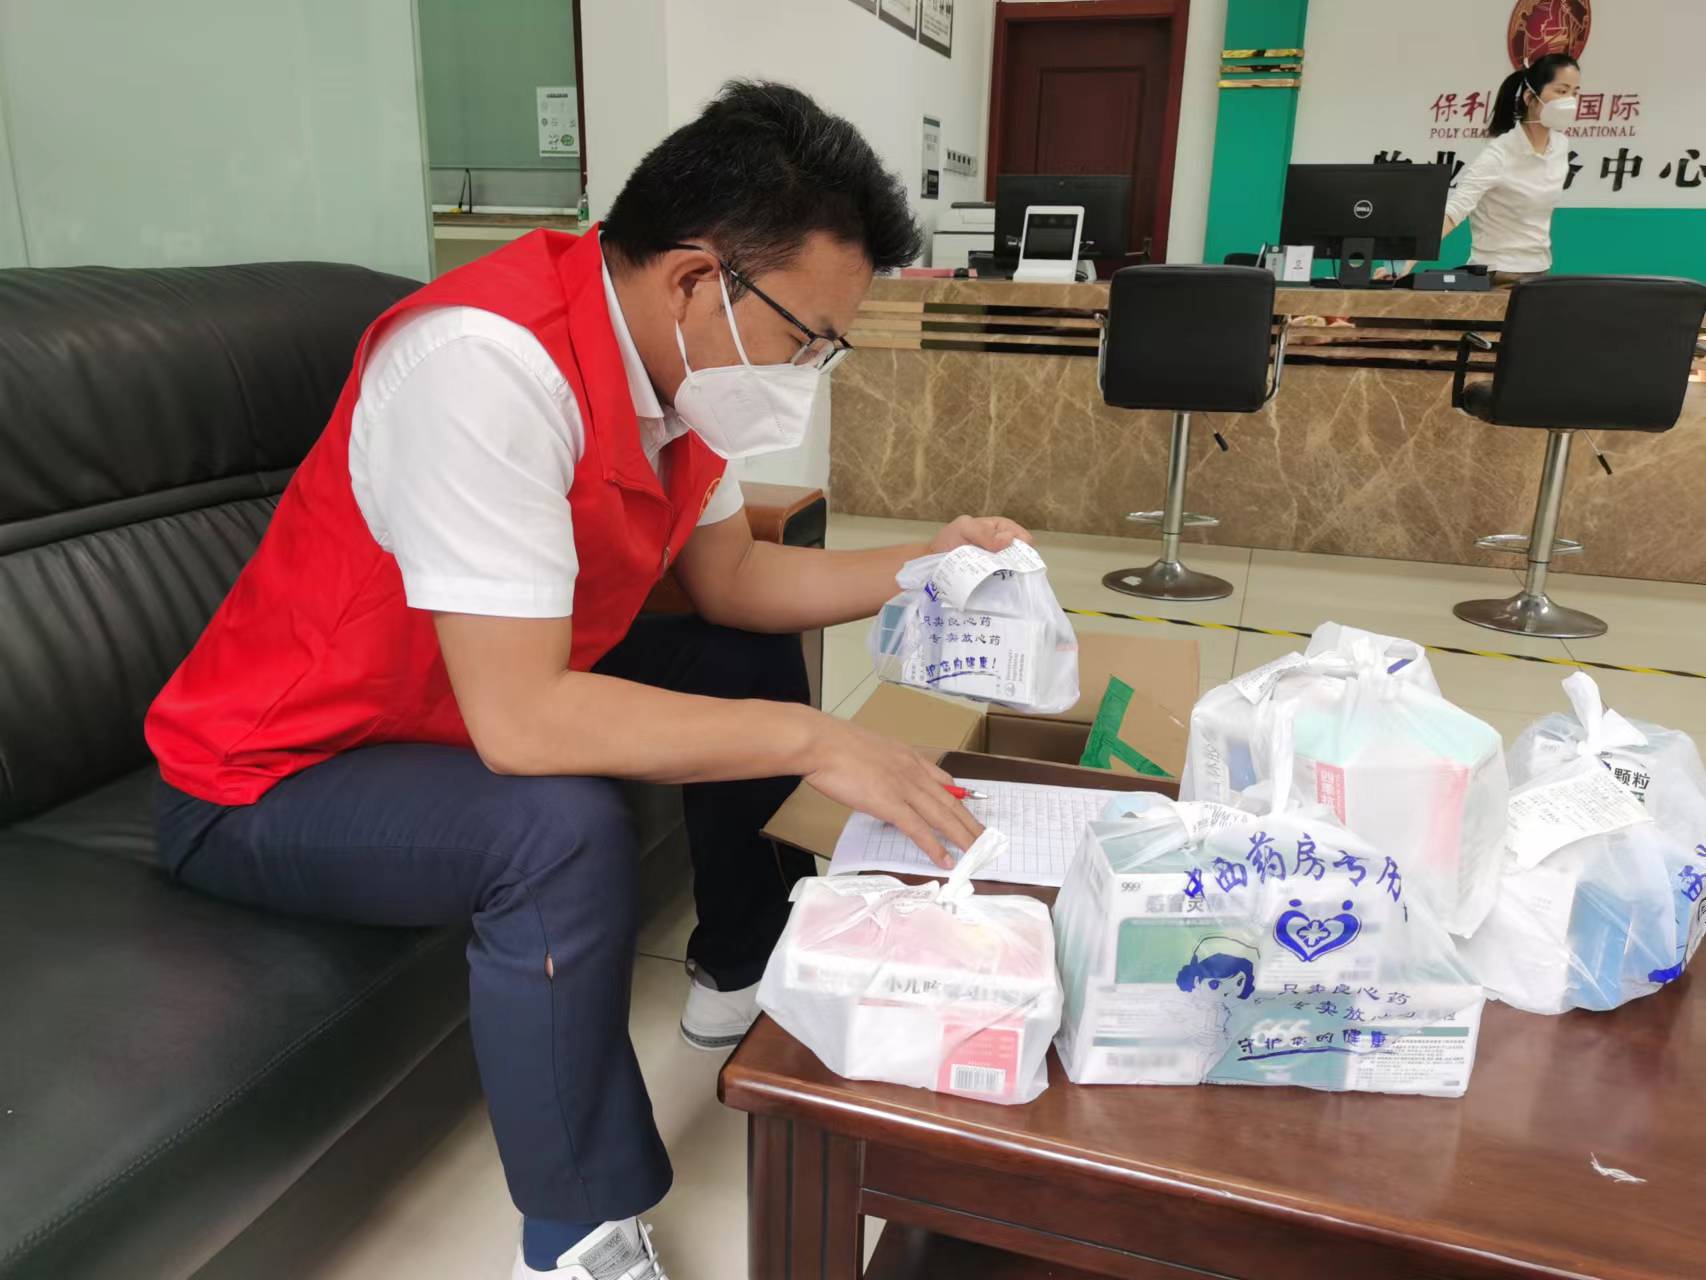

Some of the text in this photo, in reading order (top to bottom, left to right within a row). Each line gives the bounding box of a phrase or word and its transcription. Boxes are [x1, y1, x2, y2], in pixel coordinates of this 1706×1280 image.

[1430, 127, 1460, 139] POLY
[1564, 125, 1637, 138] RNATIONAL
[1614, 767, 1651, 790] 颗粒
[1120, 881, 1142, 893] 999
